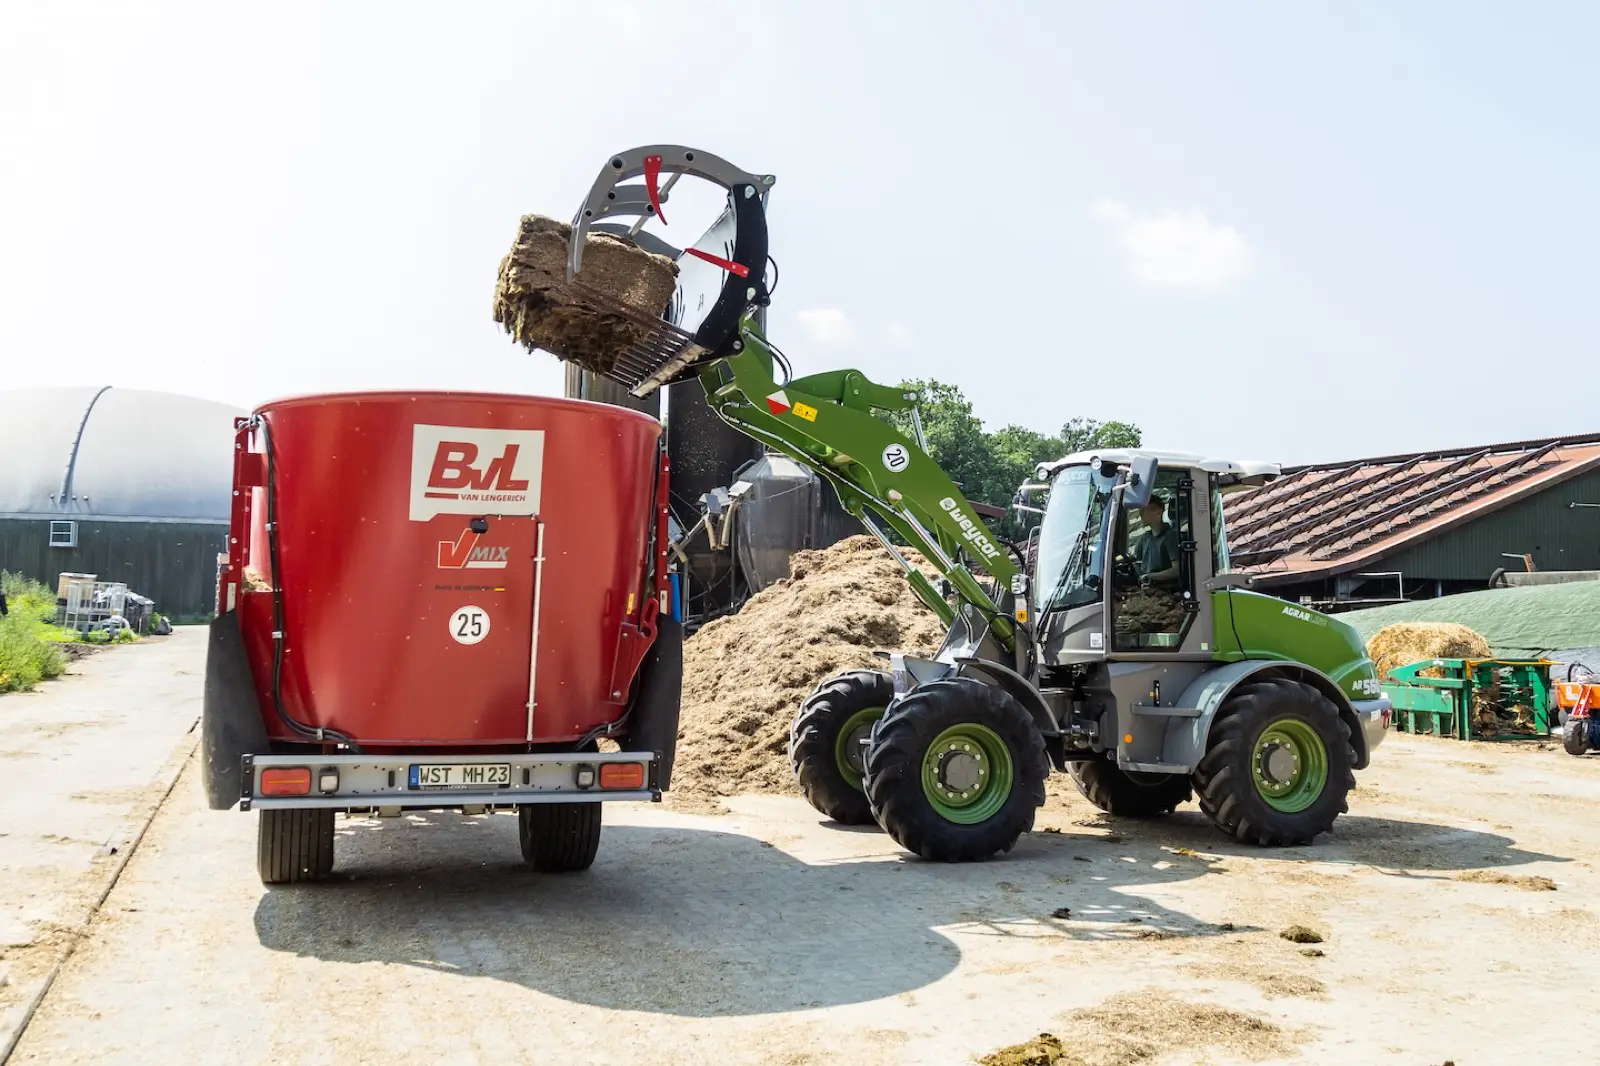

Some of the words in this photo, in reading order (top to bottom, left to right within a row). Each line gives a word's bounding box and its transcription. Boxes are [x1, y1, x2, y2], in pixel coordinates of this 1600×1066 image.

[886, 448, 906, 468] 20
[460, 493, 479, 501] VAN
[480, 494, 527, 502] LENGERICH
[948, 507, 1001, 559] weycor
[457, 613, 482, 637] 25
[420, 767, 452, 784] WST
[463, 767, 484, 783] MH
[488, 766, 508, 783] 23
